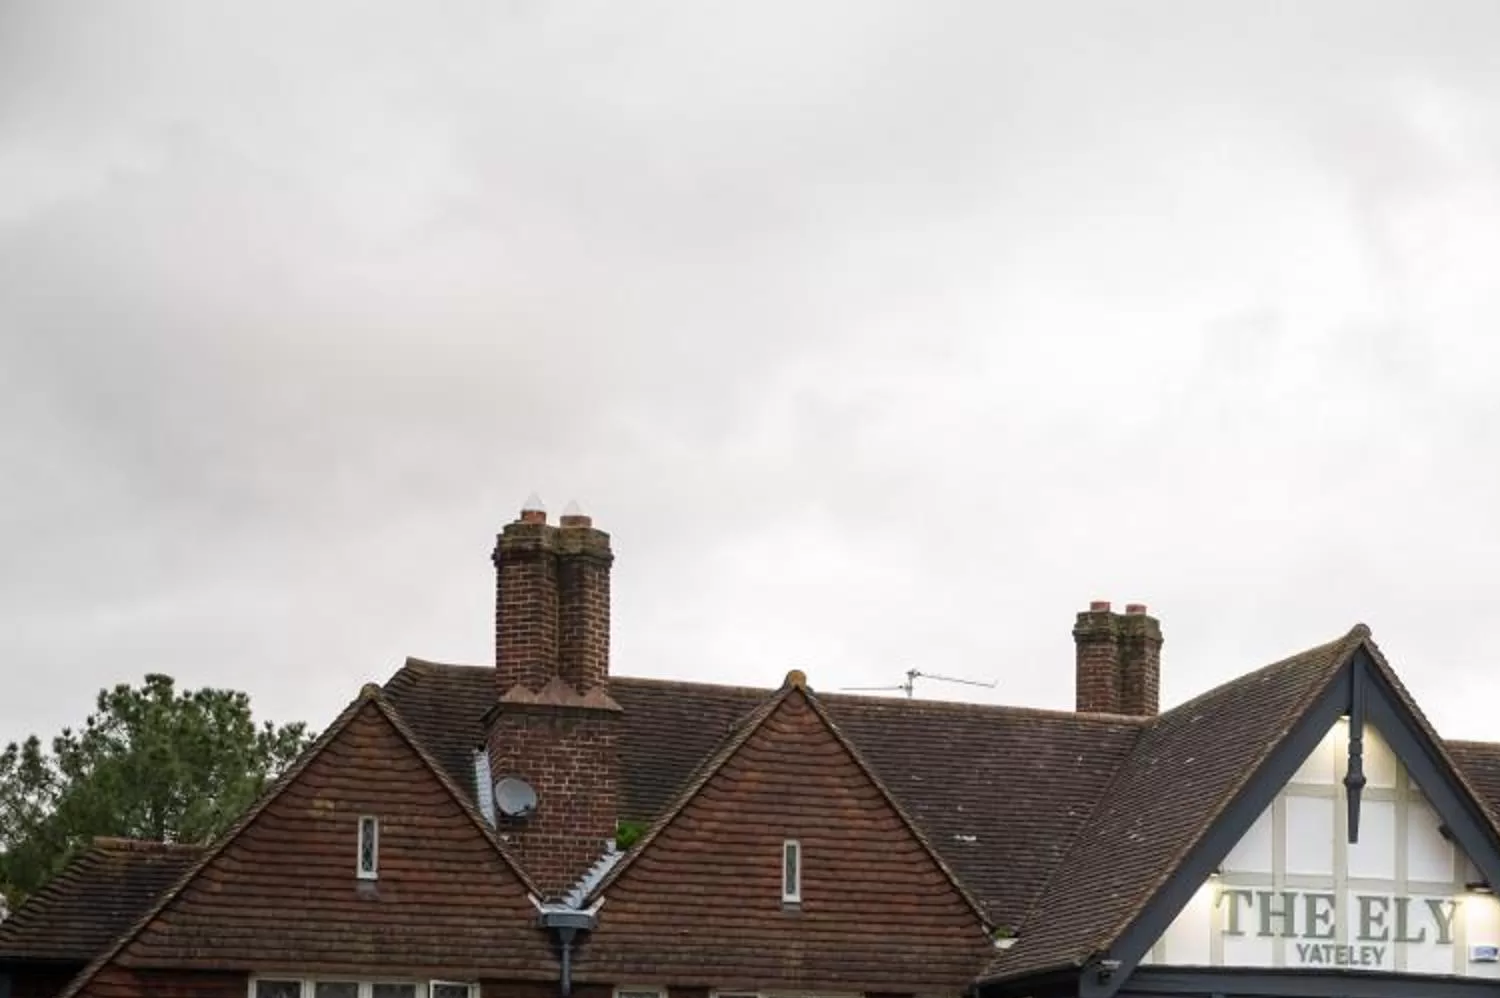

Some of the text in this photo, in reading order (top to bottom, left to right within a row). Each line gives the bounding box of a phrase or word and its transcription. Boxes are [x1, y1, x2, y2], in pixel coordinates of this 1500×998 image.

[1214, 889, 1462, 945] THE ELY
[1296, 943, 1387, 966] YATELEY
